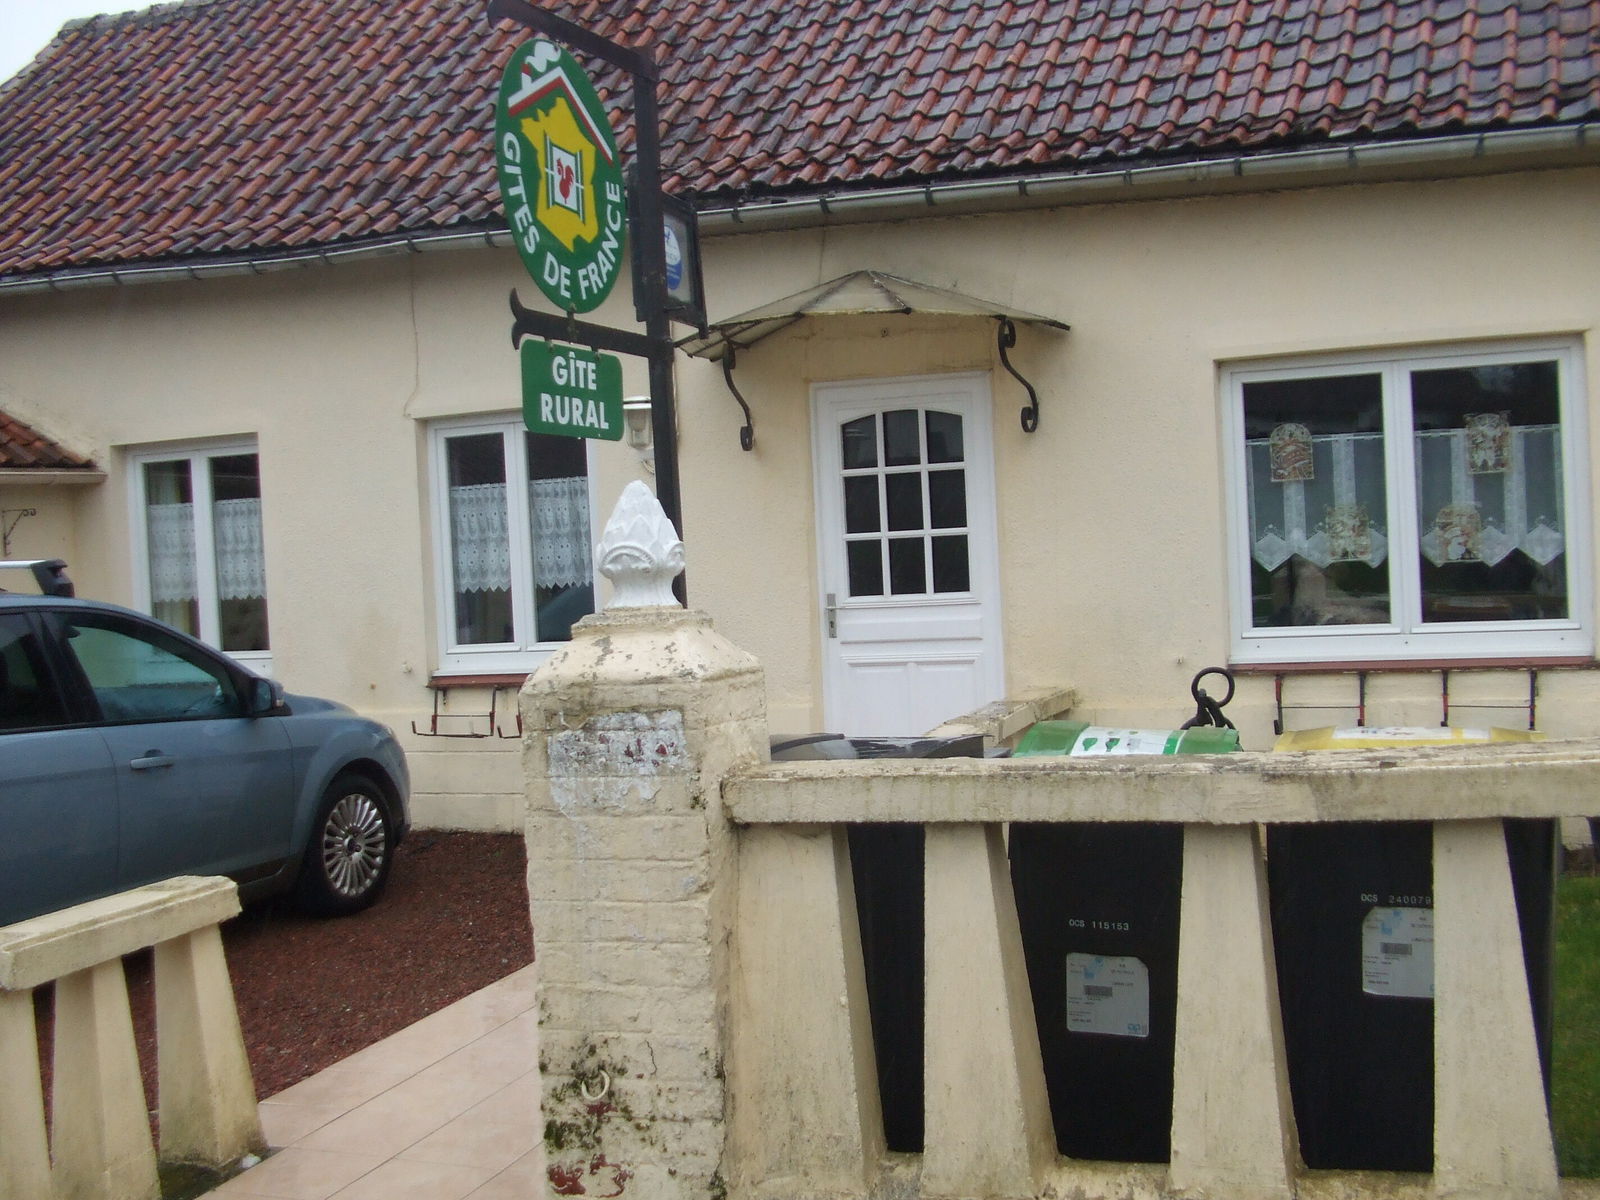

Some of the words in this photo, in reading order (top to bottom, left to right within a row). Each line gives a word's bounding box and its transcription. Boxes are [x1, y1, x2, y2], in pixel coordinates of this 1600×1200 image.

[503, 131, 540, 254] GITES
[543, 251, 571, 299] DE
[577, 181, 621, 300] FRANCE
[552, 351, 597, 390] GÎTE
[540, 392, 609, 430] RURAL
